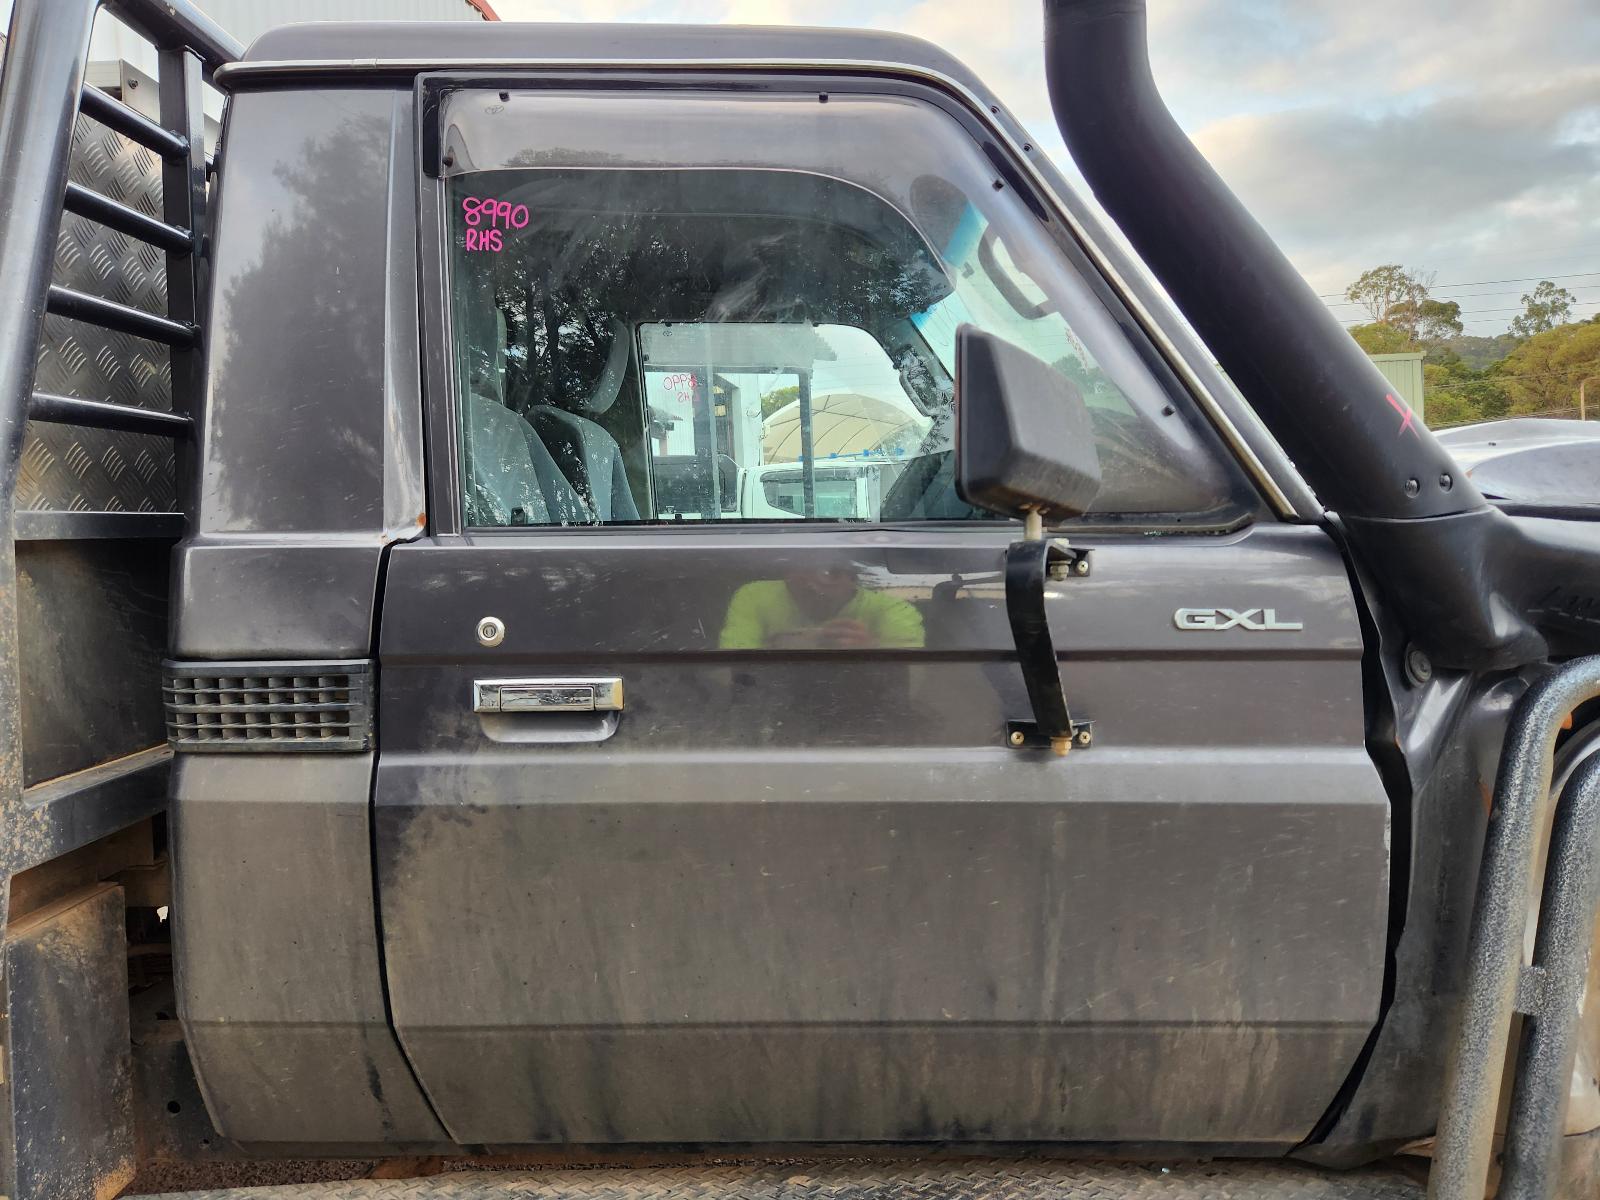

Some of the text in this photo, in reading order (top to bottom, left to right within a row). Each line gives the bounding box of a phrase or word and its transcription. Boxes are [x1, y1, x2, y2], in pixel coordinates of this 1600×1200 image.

[462, 196, 529, 229] 8990
[466, 228, 503, 252] RHS
[1174, 607, 1303, 630] GXL
